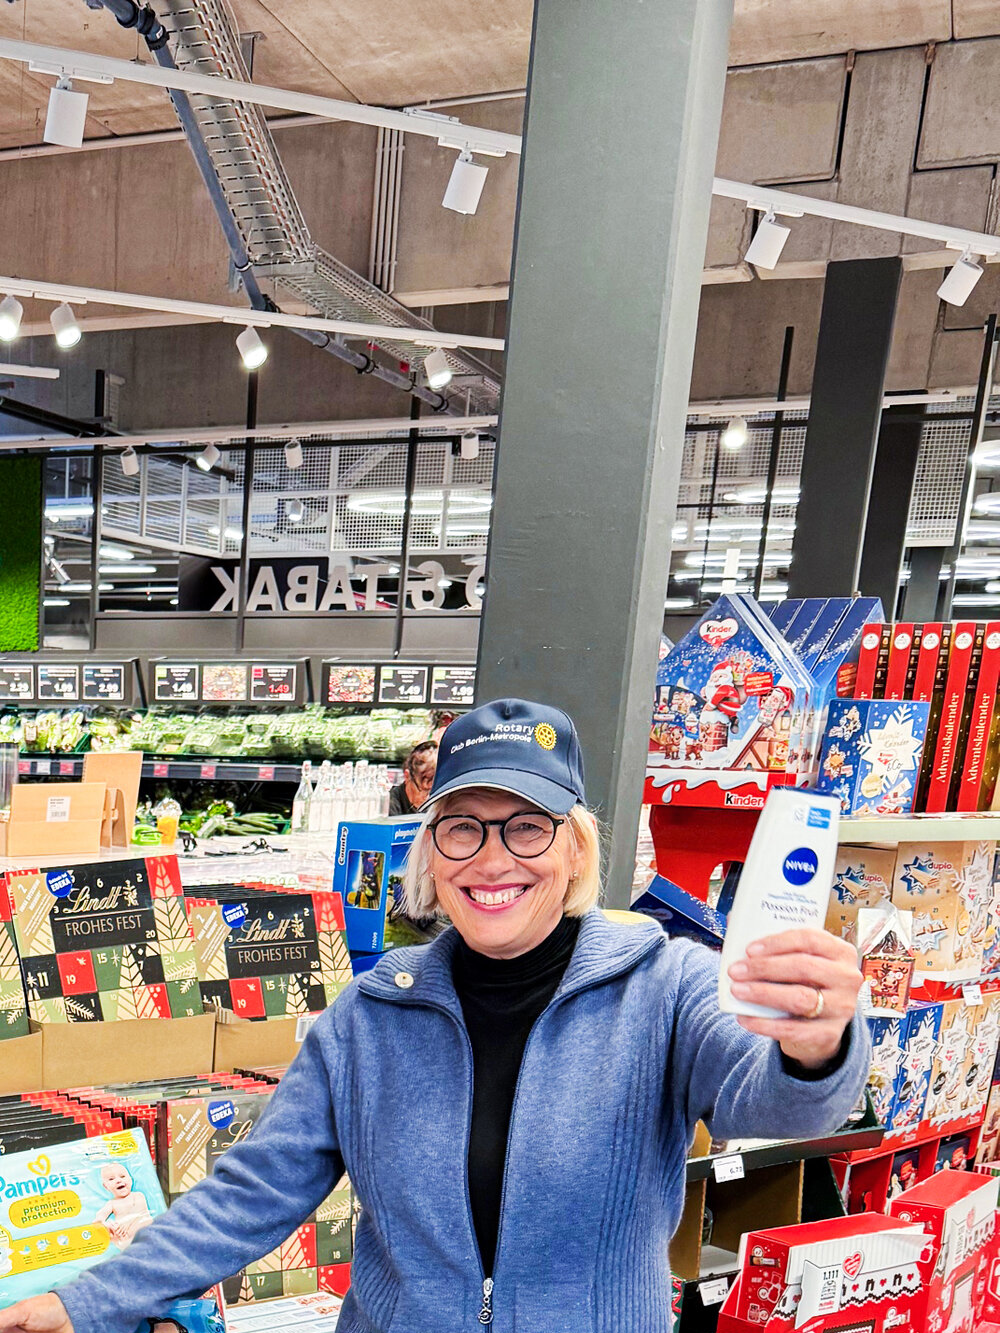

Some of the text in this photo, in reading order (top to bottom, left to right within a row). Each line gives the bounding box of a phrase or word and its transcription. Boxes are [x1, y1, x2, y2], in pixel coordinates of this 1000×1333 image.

[269, 684, 290, 695] 1.49
[495, 723, 534, 737] Rotary
[936, 692, 960, 784] Adventskalender
[967, 693, 991, 785] Adventskalender
[451, 733, 532, 754] Club Berlin-Metropole
[785, 860, 816, 874] NIVEA
[927, 862, 953, 871] duplo
[858, 873, 883, 883] duplo
[62, 885, 124, 914] Lindt
[65, 914, 143, 938] FROHES FEST
[236, 917, 291, 943] Lindt
[237, 945, 309, 965] FROHES FEST
[21, 1205, 76, 1224] protection
[22, 1199, 67, 1216] premium
